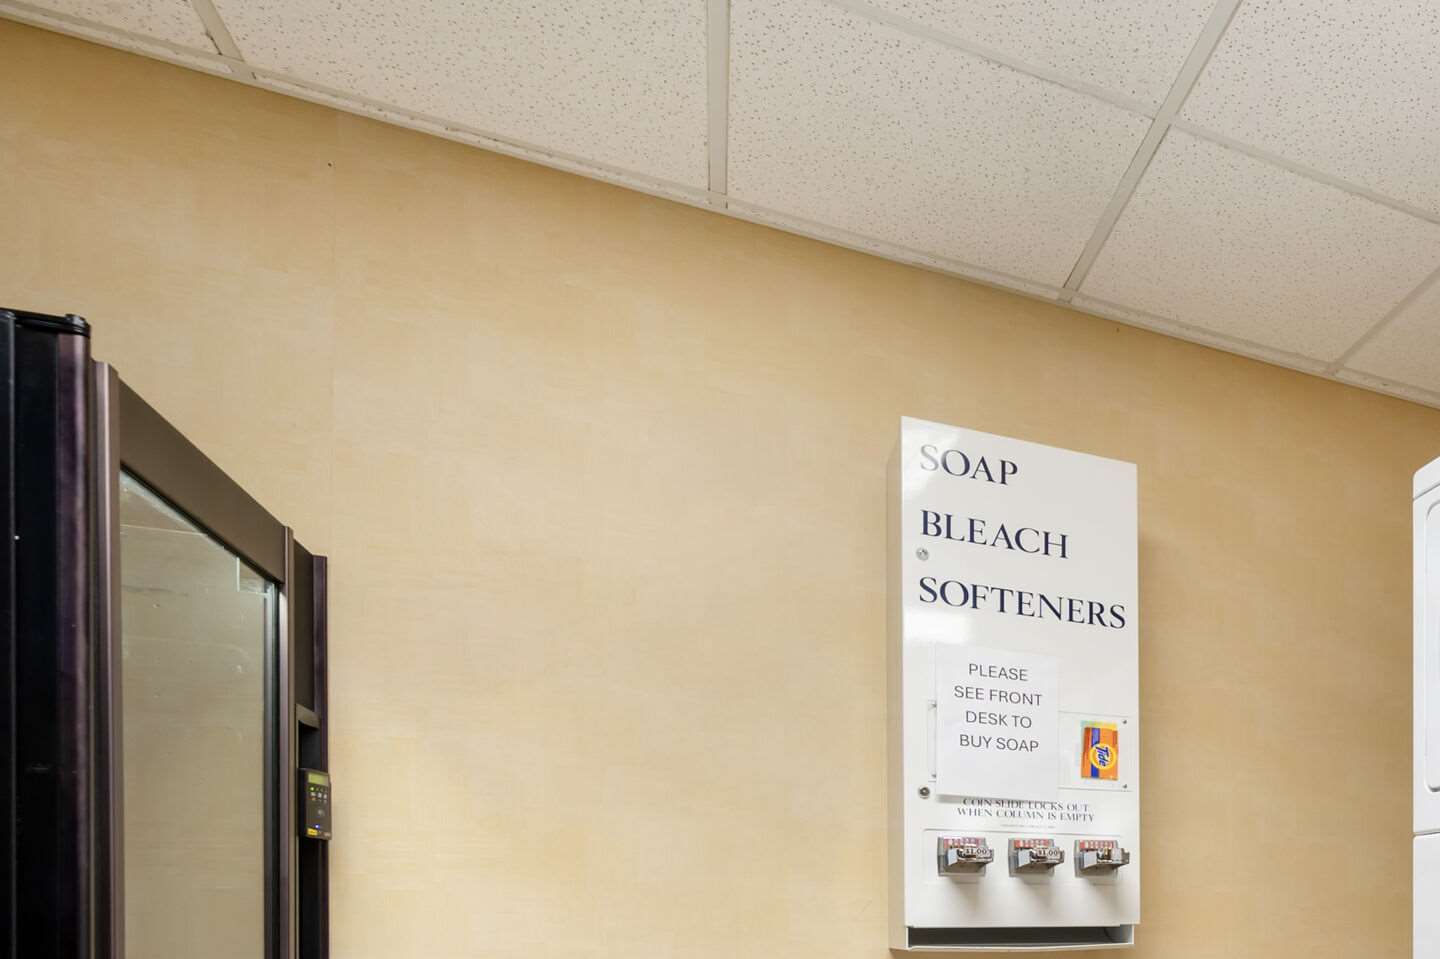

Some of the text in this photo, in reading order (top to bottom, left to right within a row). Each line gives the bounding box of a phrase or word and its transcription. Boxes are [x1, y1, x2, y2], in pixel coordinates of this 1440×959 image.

[919, 444, 1018, 485] SOAP
[920, 509, 1069, 559] BLEACH
[919, 576, 1127, 630] SOFTENERS
[968, 663, 1029, 682] PLEASE
[953, 685, 1043, 706] SEE FRONT
[965, 710, 1033, 729] DESK TO
[959, 733, 1040, 753] BUY SOAP
[1095, 746, 1110, 767] Tide
[957, 807, 1095, 822] WHEN COLUMN IS EMPTY
[962, 798, 992, 807] COIN
[1066, 803, 1090, 813] OUT
